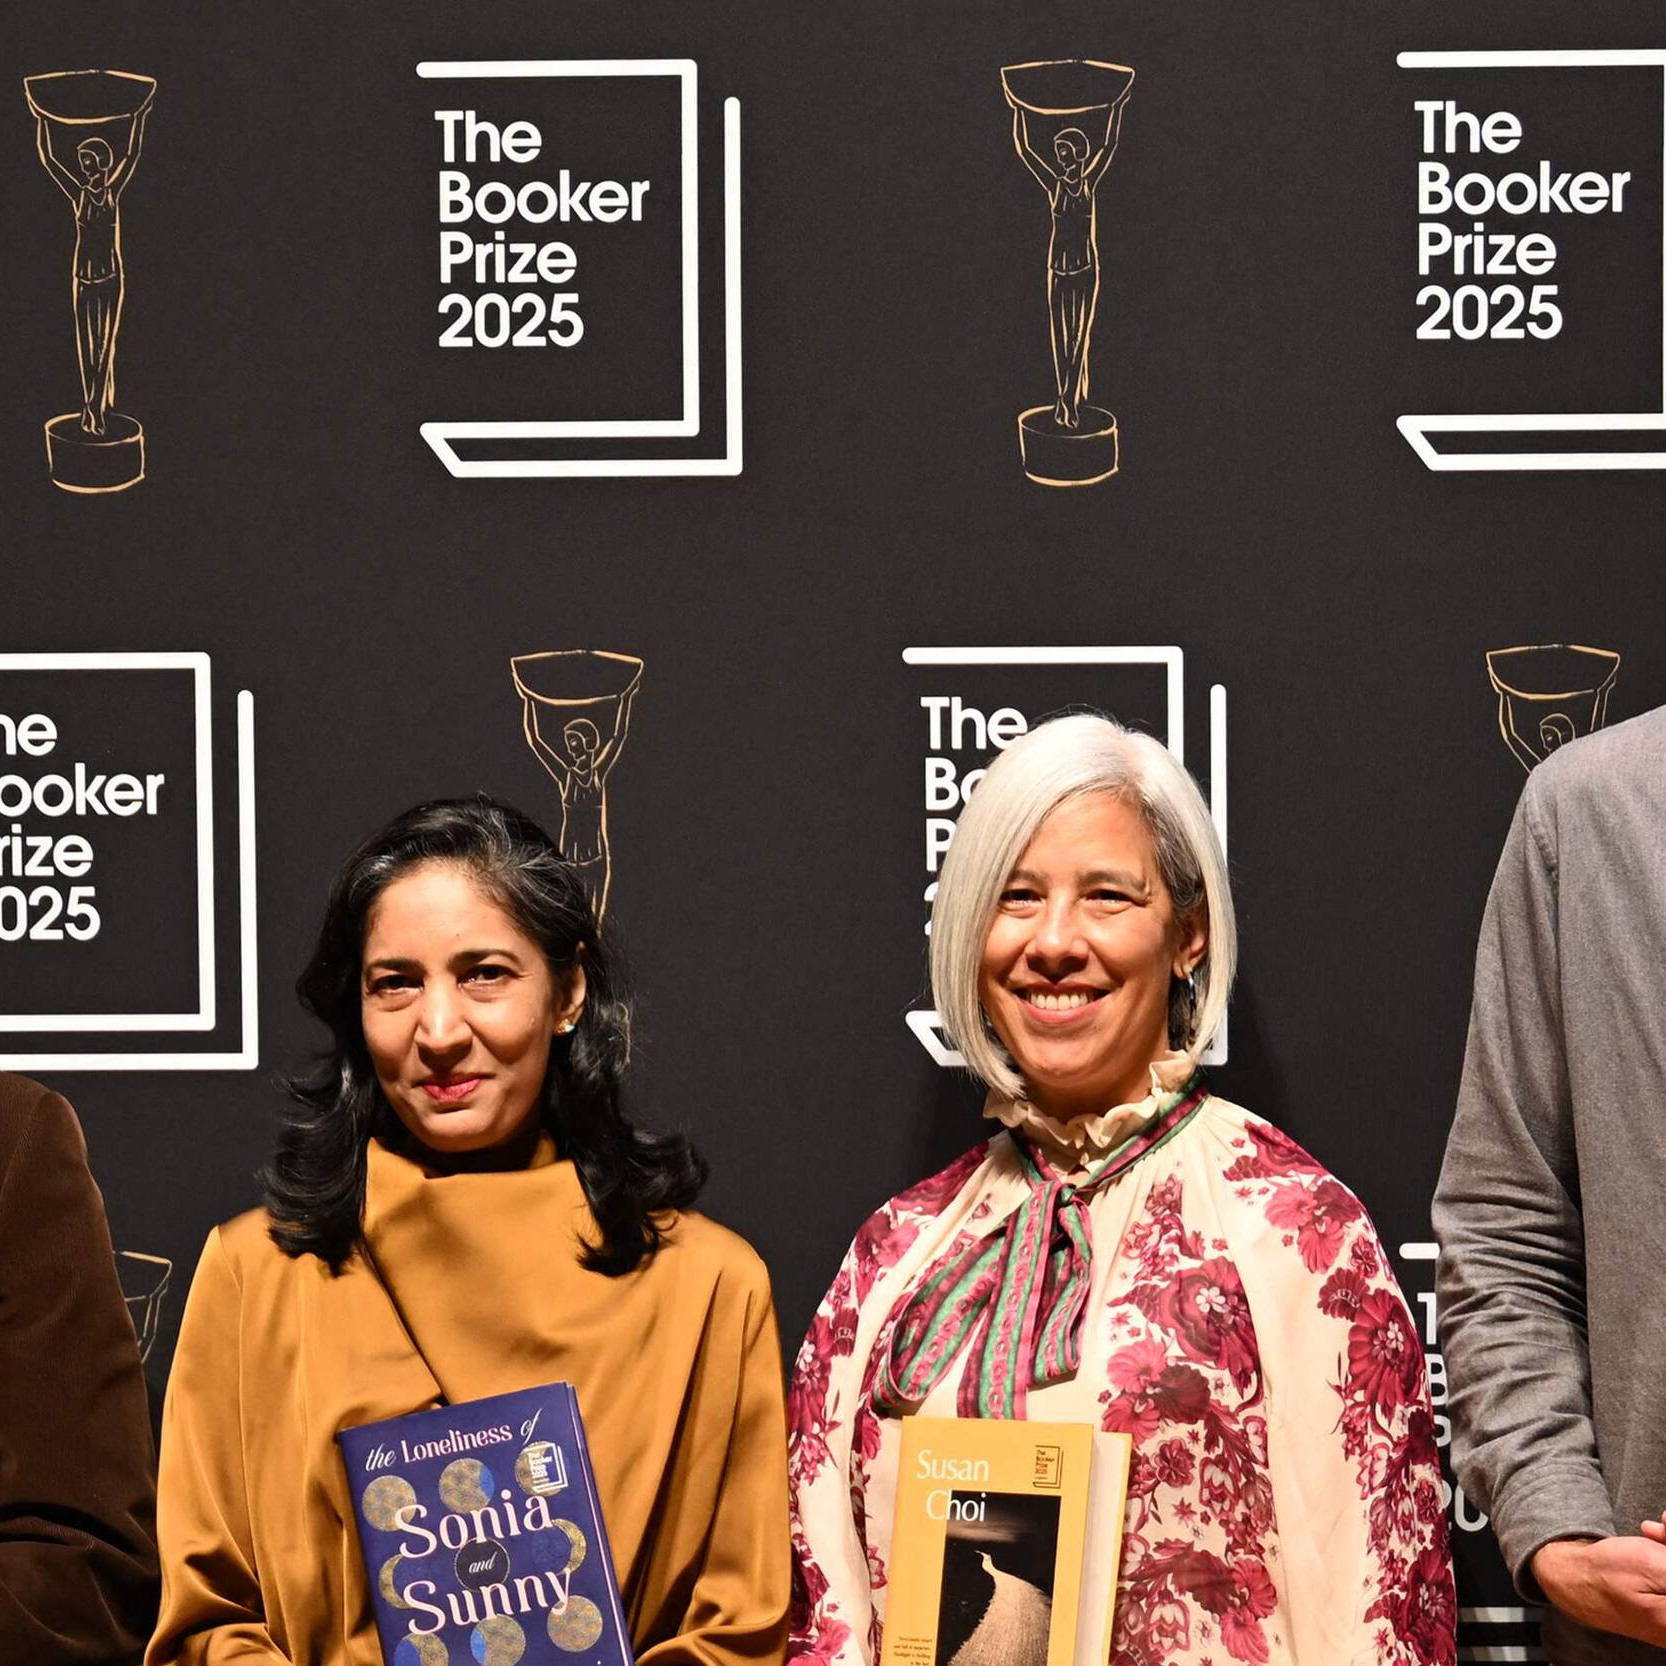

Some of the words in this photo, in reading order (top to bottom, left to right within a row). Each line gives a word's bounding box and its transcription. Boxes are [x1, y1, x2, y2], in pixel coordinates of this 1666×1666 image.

[435, 110, 542, 163] The
[1414, 101, 1522, 153] The
[440, 170, 650, 223] Booker
[1419, 161, 1630, 215] Booker
[440, 231, 577, 283] Prize
[1419, 222, 1556, 275] Prize
[438, 293, 584, 347] 2025
[1416, 285, 1563, 340] 2025
[920, 697, 1028, 749] The
[365, 1443, 397, 1472] the
[401, 1424, 513, 1463] Loneliness
[520, 1407, 543, 1444] of
[916, 1449, 989, 1482] Susan
[394, 1489, 553, 1558] Sonia
[926, 1489, 986, 1522] Choi
[468, 1551, 498, 1574] and
[403, 1567, 571, 1635] Sunny
